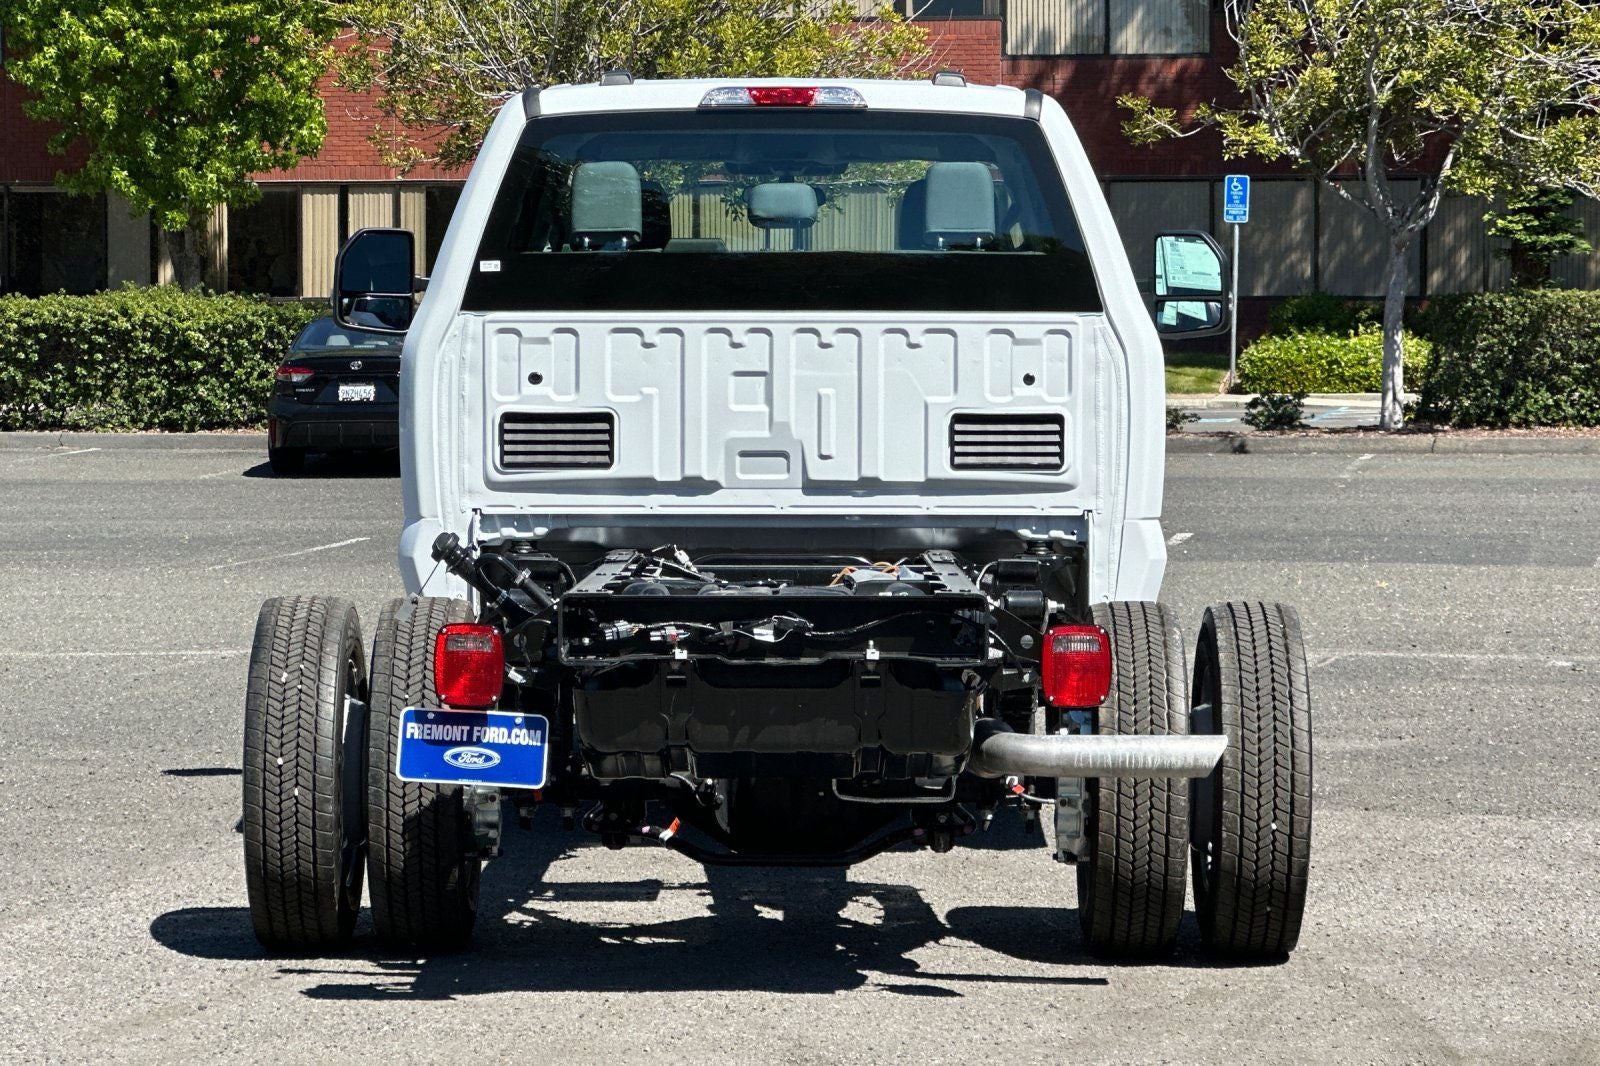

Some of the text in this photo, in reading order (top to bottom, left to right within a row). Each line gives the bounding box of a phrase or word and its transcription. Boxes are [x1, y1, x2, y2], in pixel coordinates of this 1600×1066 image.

[406, 722, 542, 746] FREMONT FORD.COM
[458, 751, 486, 764] Ford
